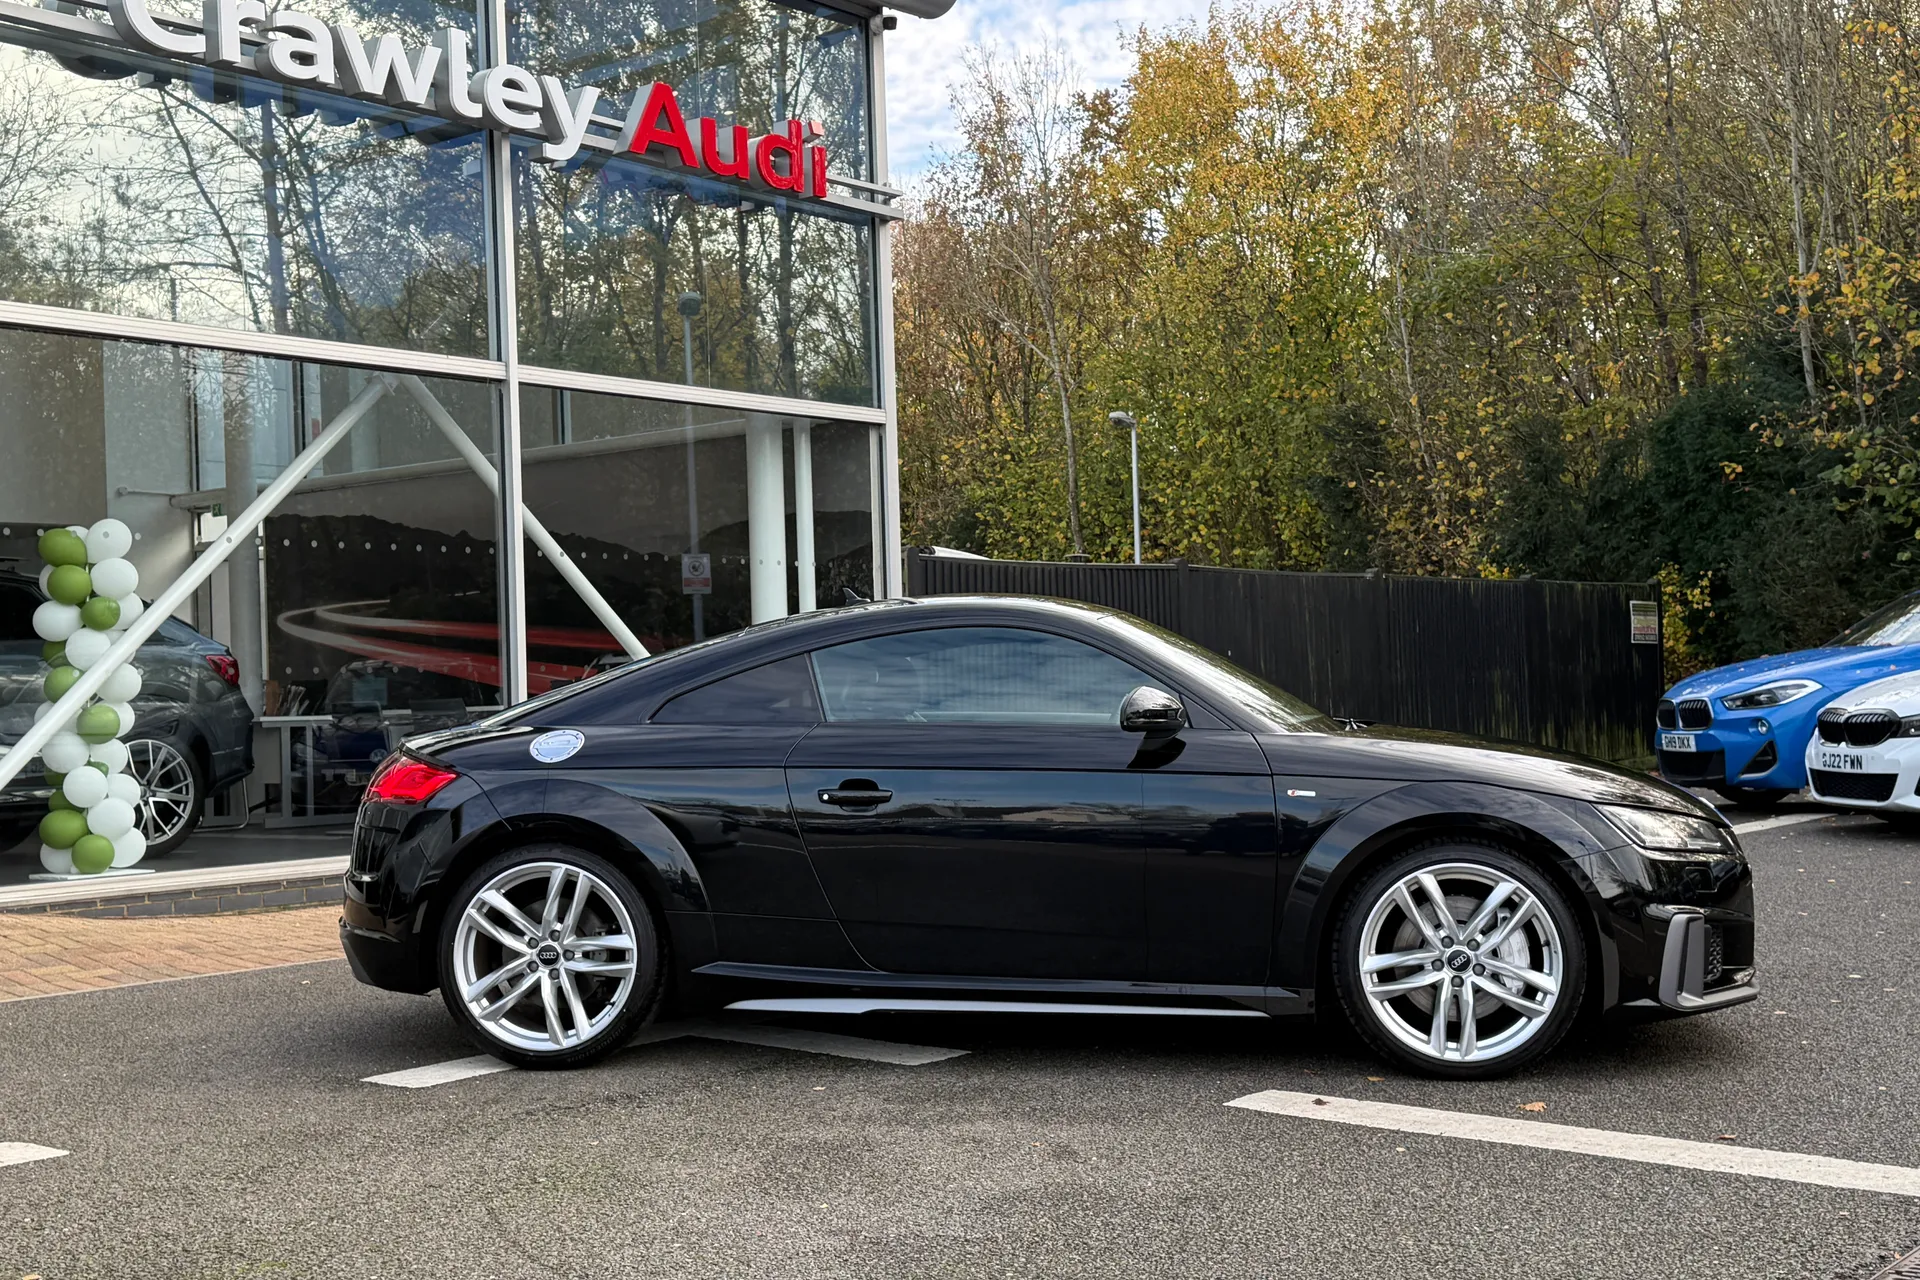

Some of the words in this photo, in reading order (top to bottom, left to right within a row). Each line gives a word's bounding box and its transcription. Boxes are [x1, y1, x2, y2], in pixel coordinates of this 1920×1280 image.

[627, 81, 827, 198] Audi
[1822, 752, 1842, 769] GJ22
[1843, 754, 1863, 770] FWN
